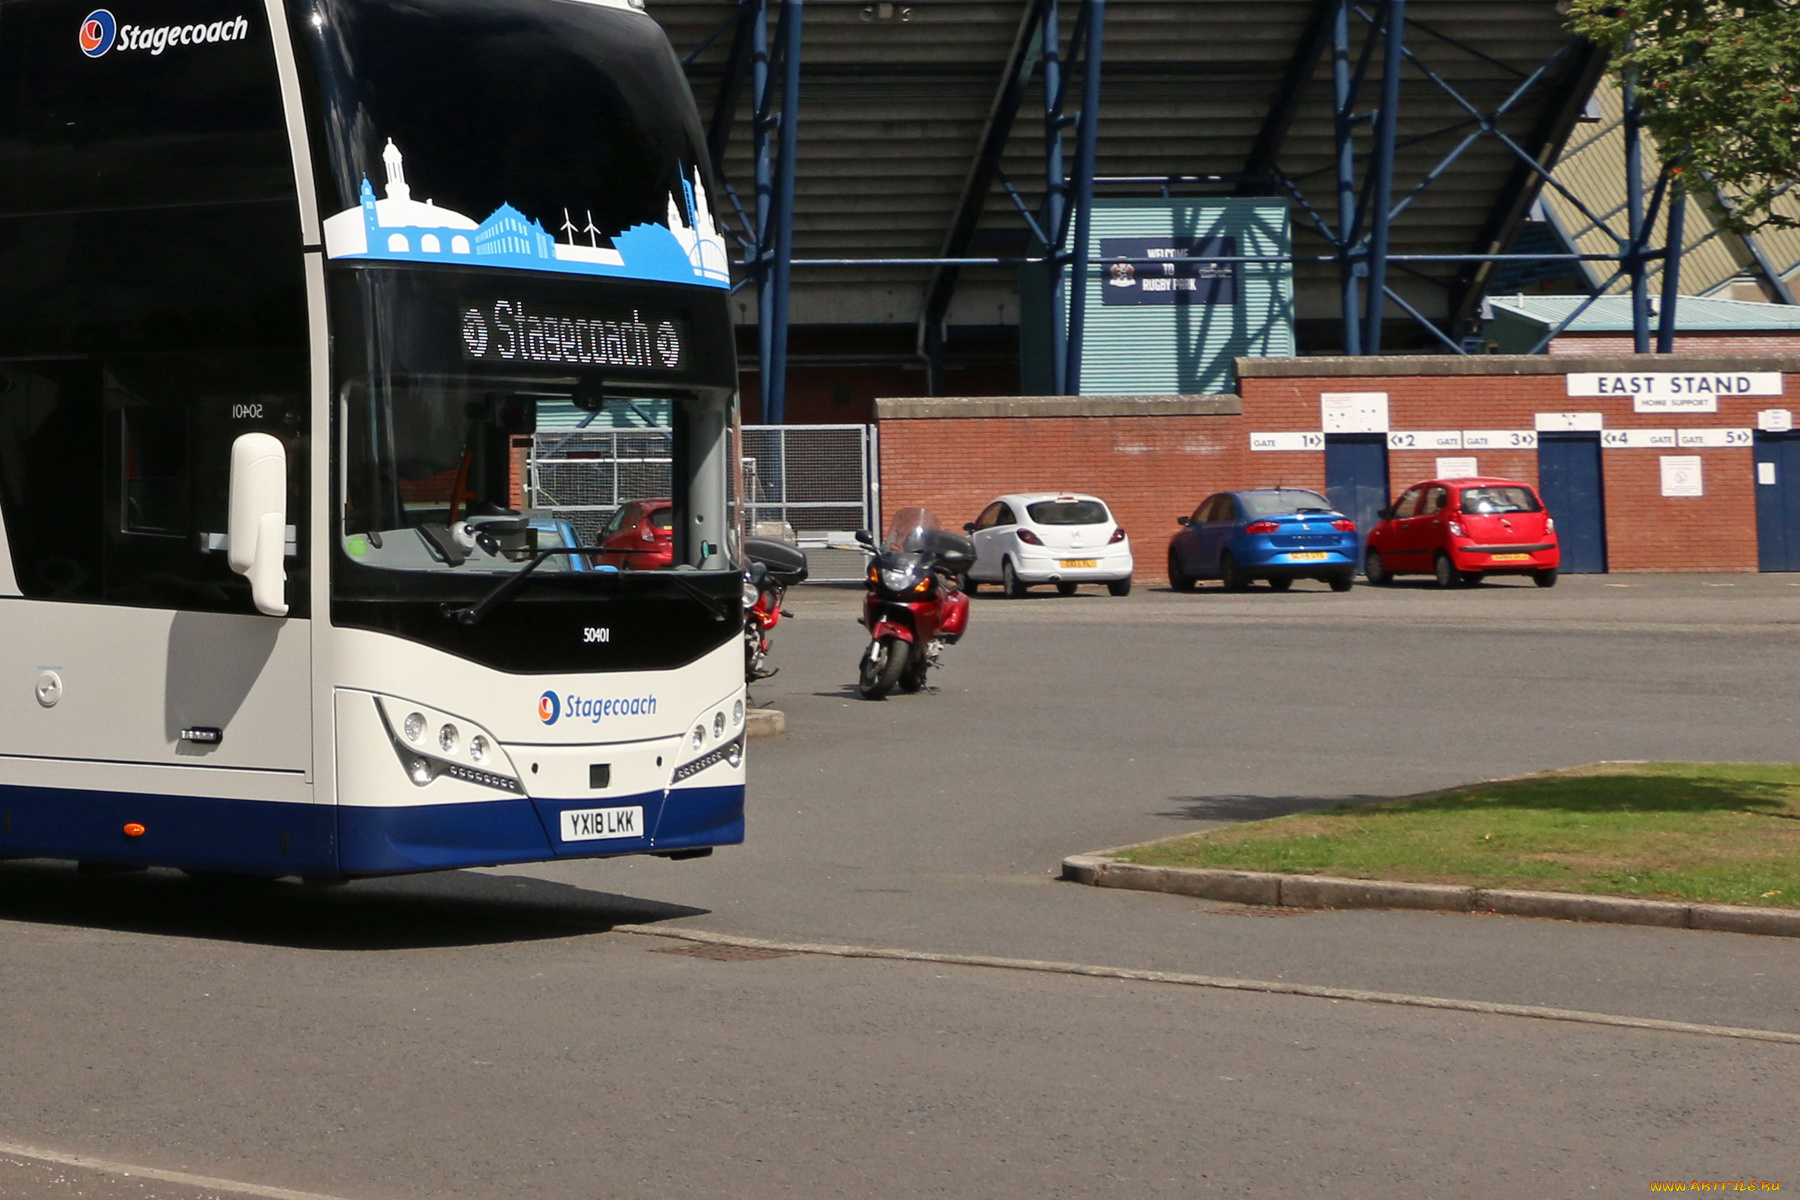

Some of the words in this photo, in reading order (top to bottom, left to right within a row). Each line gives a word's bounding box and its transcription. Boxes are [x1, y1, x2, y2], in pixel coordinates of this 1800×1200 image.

[116, 15, 248, 55] Stagecoach
[1162, 263, 1175, 275] TO
[1142, 278, 1171, 291] RUGBY
[1172, 278, 1197, 291] PARK
[495, 300, 652, 366] Stagecoach
[1598, 377, 1654, 393] EAST
[1671, 376, 1751, 393] STAND
[1254, 439, 1275, 447] GATE
[1302, 435, 1308, 447] 1
[1406, 434, 1415, 447] 2
[1437, 438, 1458, 446] GATE
[1466, 437, 1488, 445] GATE
[1511, 433, 1520, 446] 3
[1618, 432, 1629, 444] 4
[1651, 435, 1672, 444] GATE
[1682, 435, 1703, 444] GATE
[1725, 431, 1735, 444] 5
[583, 627, 610, 642] 50401
[565, 694, 657, 723] Stagecoach
[571, 813, 604, 835] YX18
[608, 810, 634, 832] LKK
